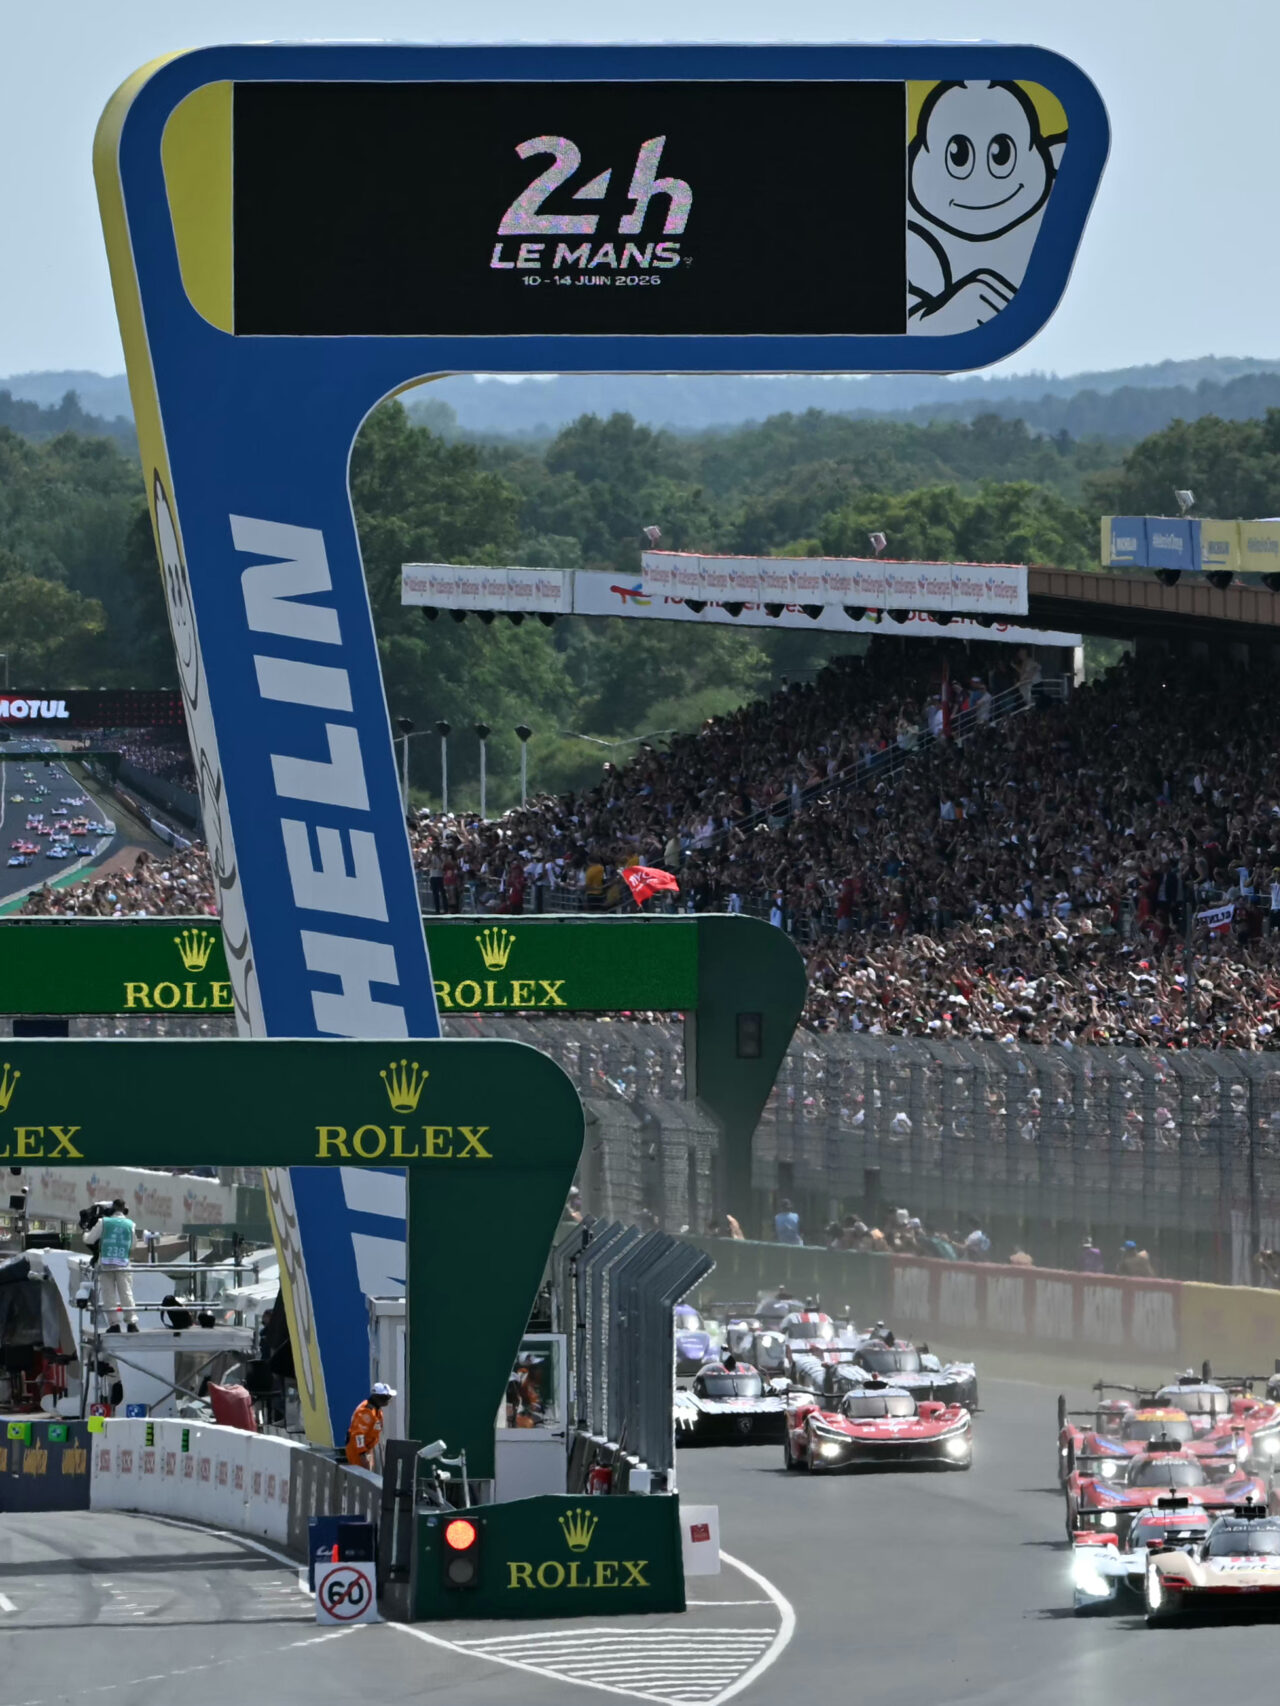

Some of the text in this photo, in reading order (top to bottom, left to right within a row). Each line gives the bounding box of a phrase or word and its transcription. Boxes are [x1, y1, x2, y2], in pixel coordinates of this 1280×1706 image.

[490, 242, 681, 268] LE MANS
[575, 276, 611, 286] JUIN
[615, 276, 661, 286] 2026
[229, 513, 409, 1300] IHELIN
[123, 982, 235, 1008] ROLE
[315, 1126, 493, 1158] ROLEX
[507, 1560, 650, 1589] ROLEX
[327, 1580, 364, 1606] 60
